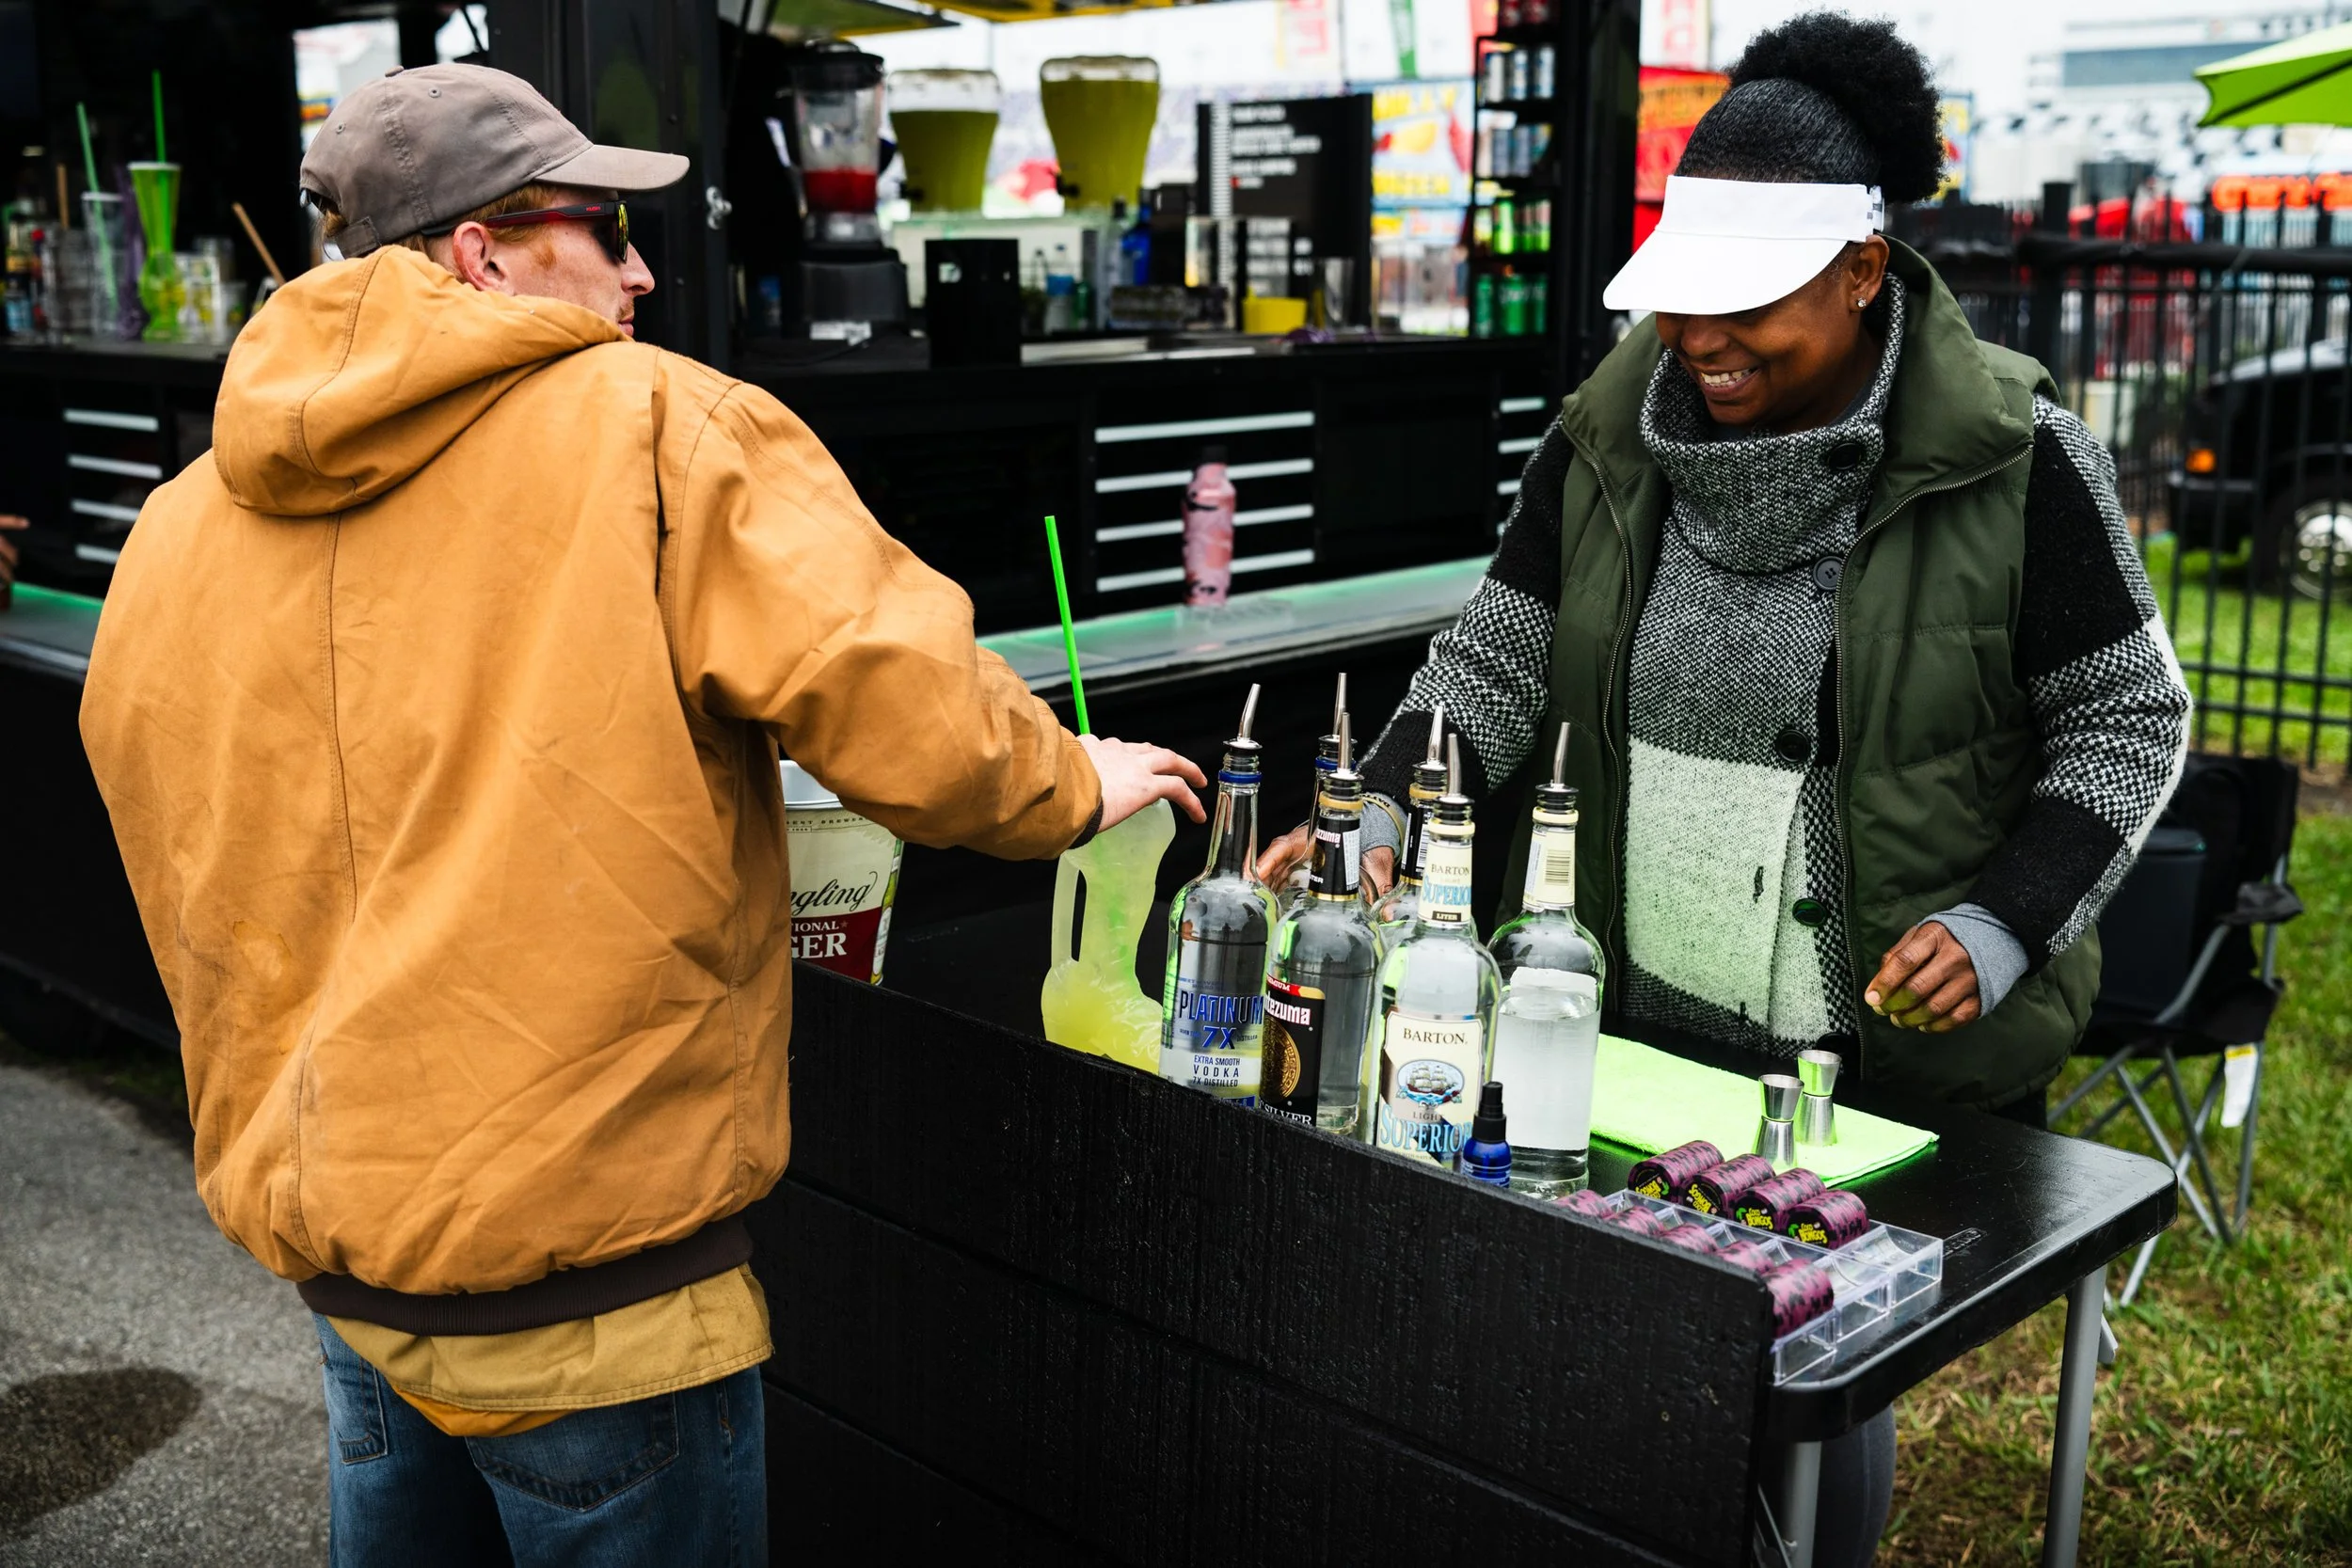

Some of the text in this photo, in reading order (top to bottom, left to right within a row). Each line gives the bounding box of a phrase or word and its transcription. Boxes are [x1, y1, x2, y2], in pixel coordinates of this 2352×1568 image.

[1431, 863, 1470, 876] BARTON
[1436, 912, 1458, 921] LITER
[791, 921, 839, 932] IONAL
[1179, 990, 1263, 1025] PLATINUM
[1202, 1025, 1237, 1050] 7X
[1403, 1027, 1465, 1044] BARTON
[1194, 1054, 1240, 1066] EXTRA SMOOTH
[1193, 1064, 1239, 1078] VODKA
[1192, 1076, 1239, 1087] 7X DISTILLED
[1264, 1103, 1312, 1125] SILVER
[1745, 1213, 1774, 1230] BONGOS
[1798, 1228, 1828, 1244] BONGOS
